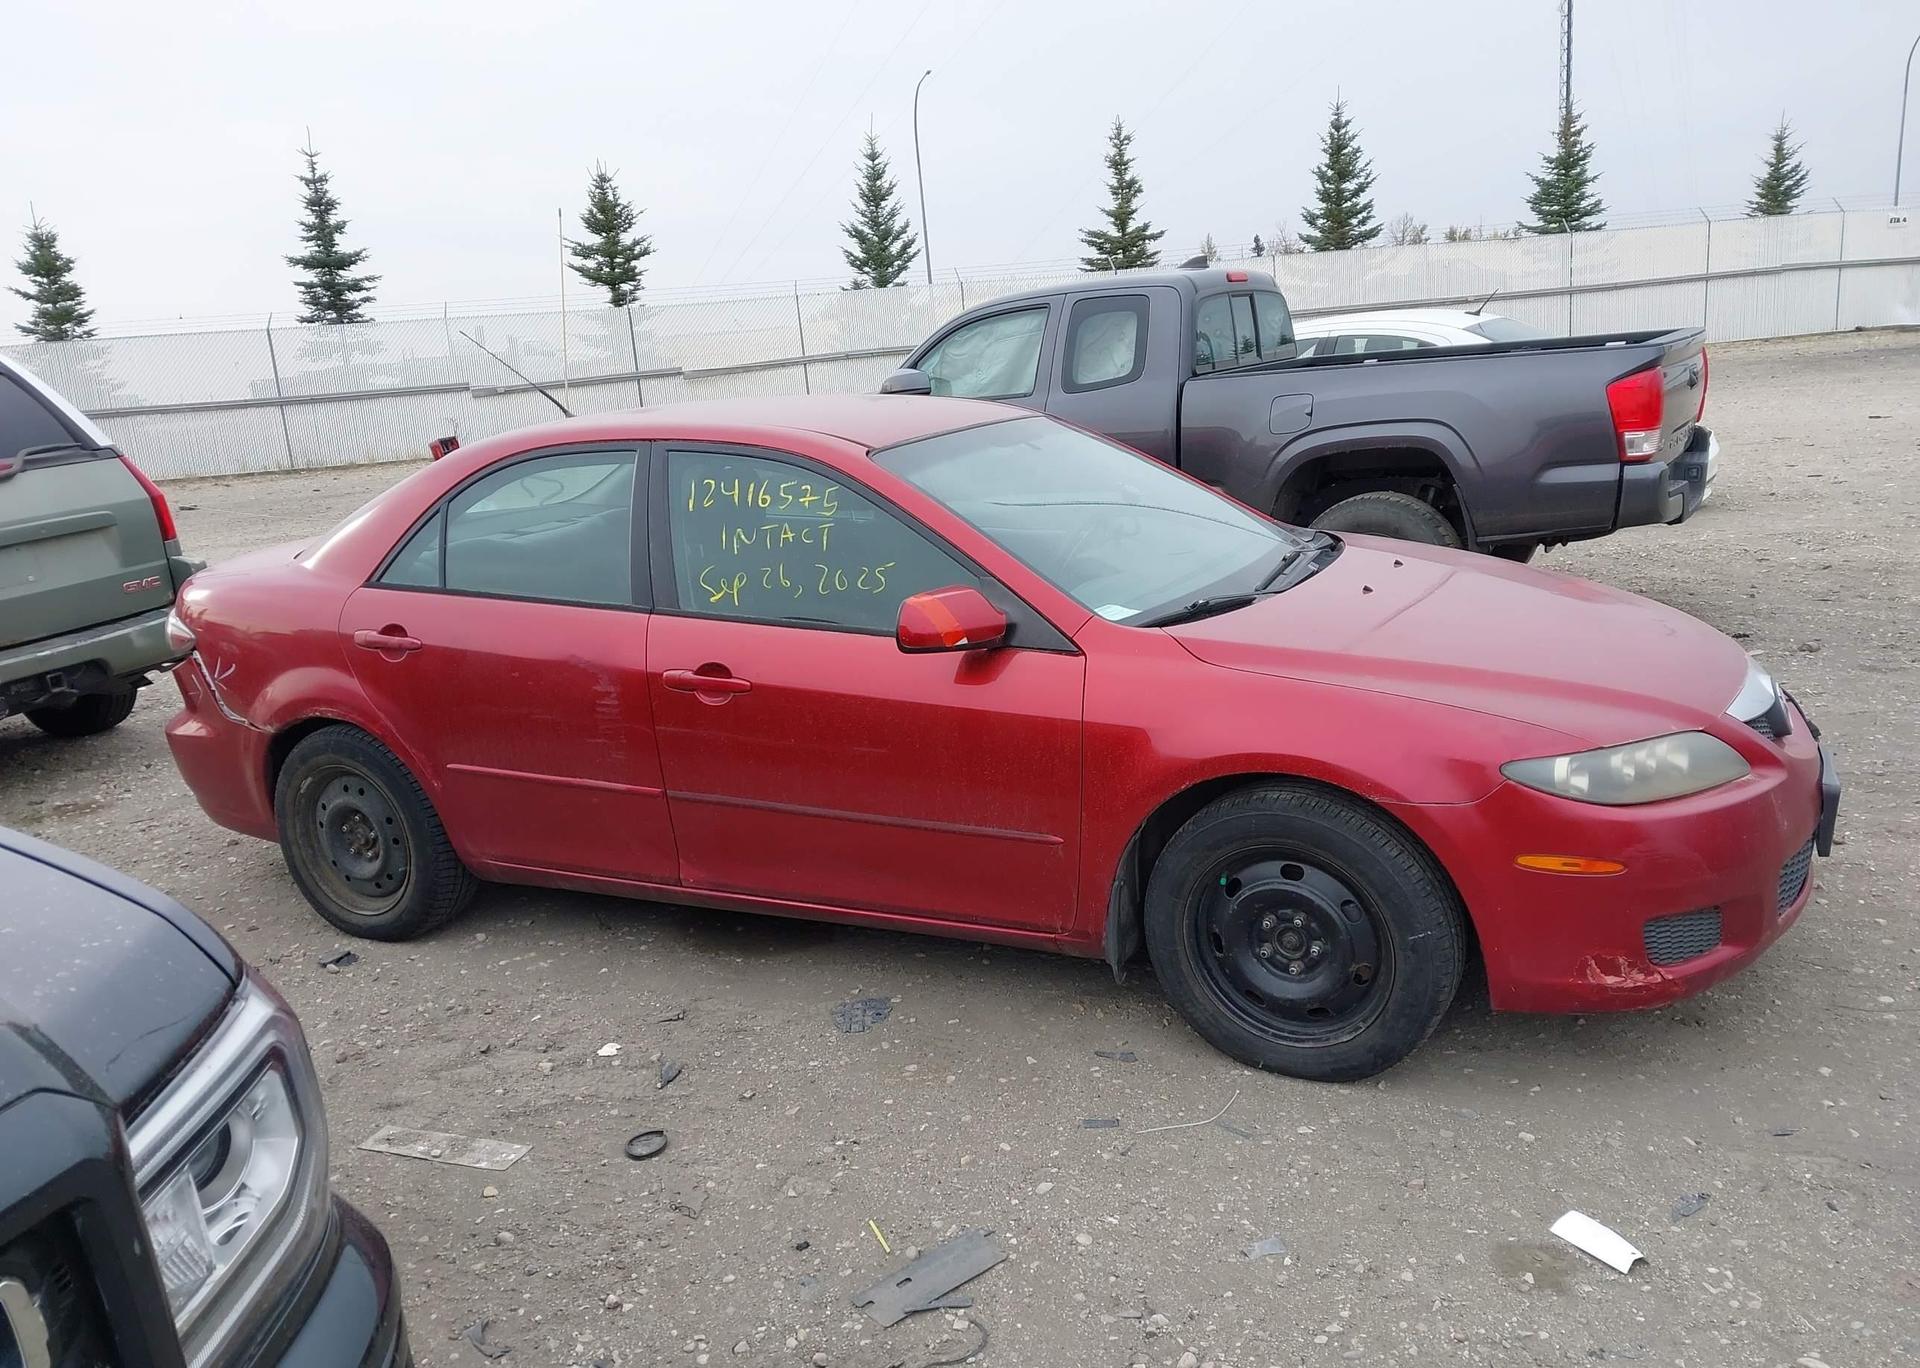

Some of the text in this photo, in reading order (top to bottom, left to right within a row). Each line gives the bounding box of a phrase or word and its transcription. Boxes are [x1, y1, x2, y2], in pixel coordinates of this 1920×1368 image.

[688, 479, 840, 515] 12416575
[722, 523, 835, 554] INTACT
[123, 576, 161, 593] GMC
[700, 562, 896, 606] Sep 26, 2025
